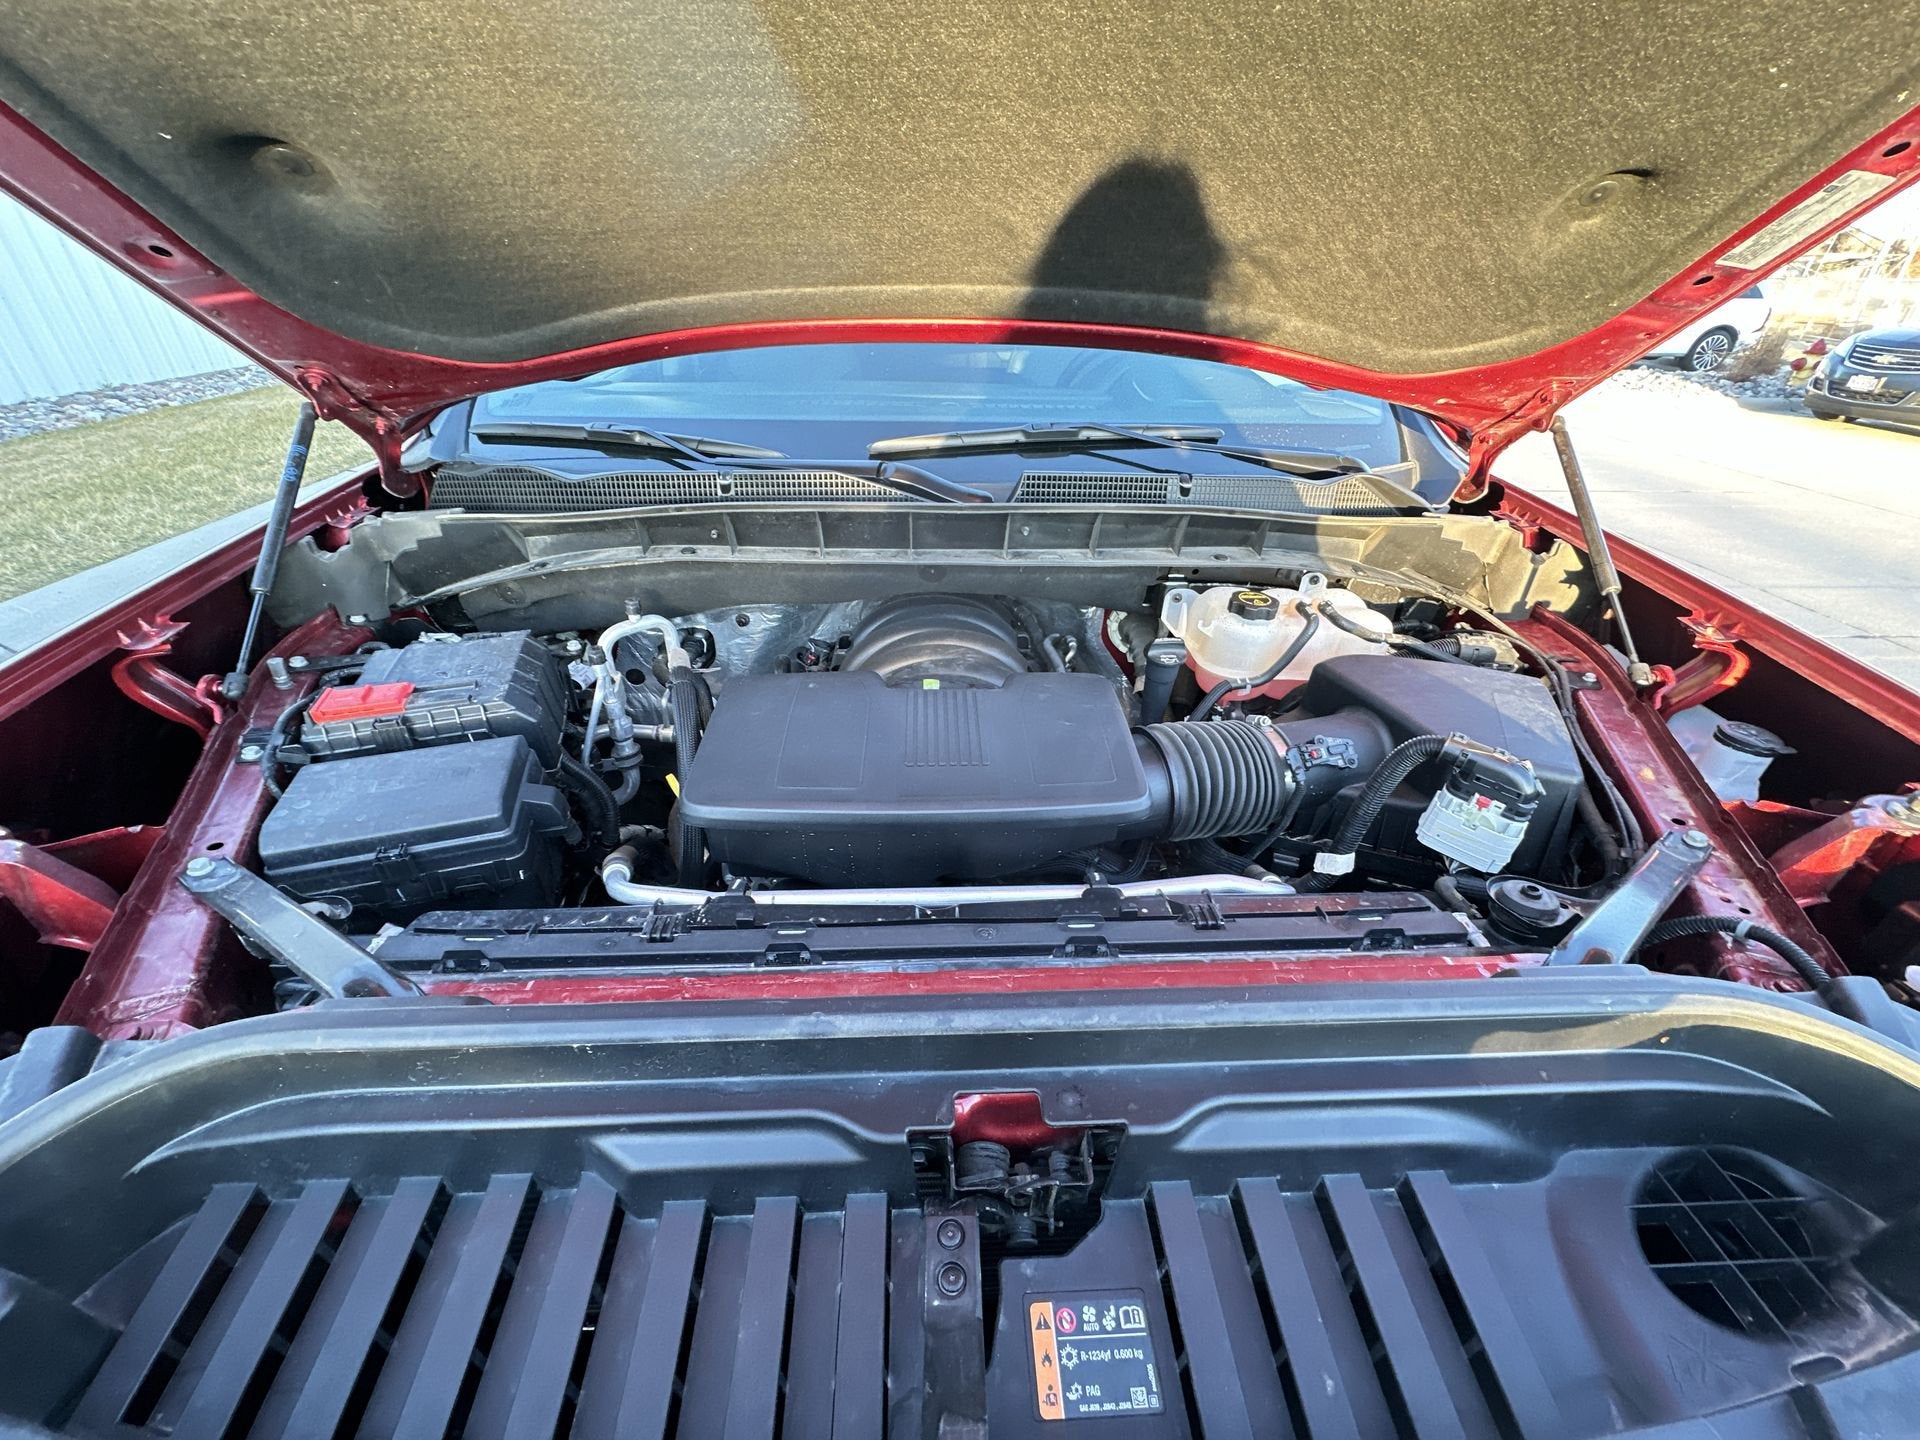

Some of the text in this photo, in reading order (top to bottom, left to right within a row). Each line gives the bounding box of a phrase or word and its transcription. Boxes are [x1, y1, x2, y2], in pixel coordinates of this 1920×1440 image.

[1084, 1323, 1100, 1332] AUTO
[1080, 1350, 1111, 1362] R-1234yf
[1134, 1348, 1144, 1360] kg
[1086, 1385, 1100, 1396] PAG
